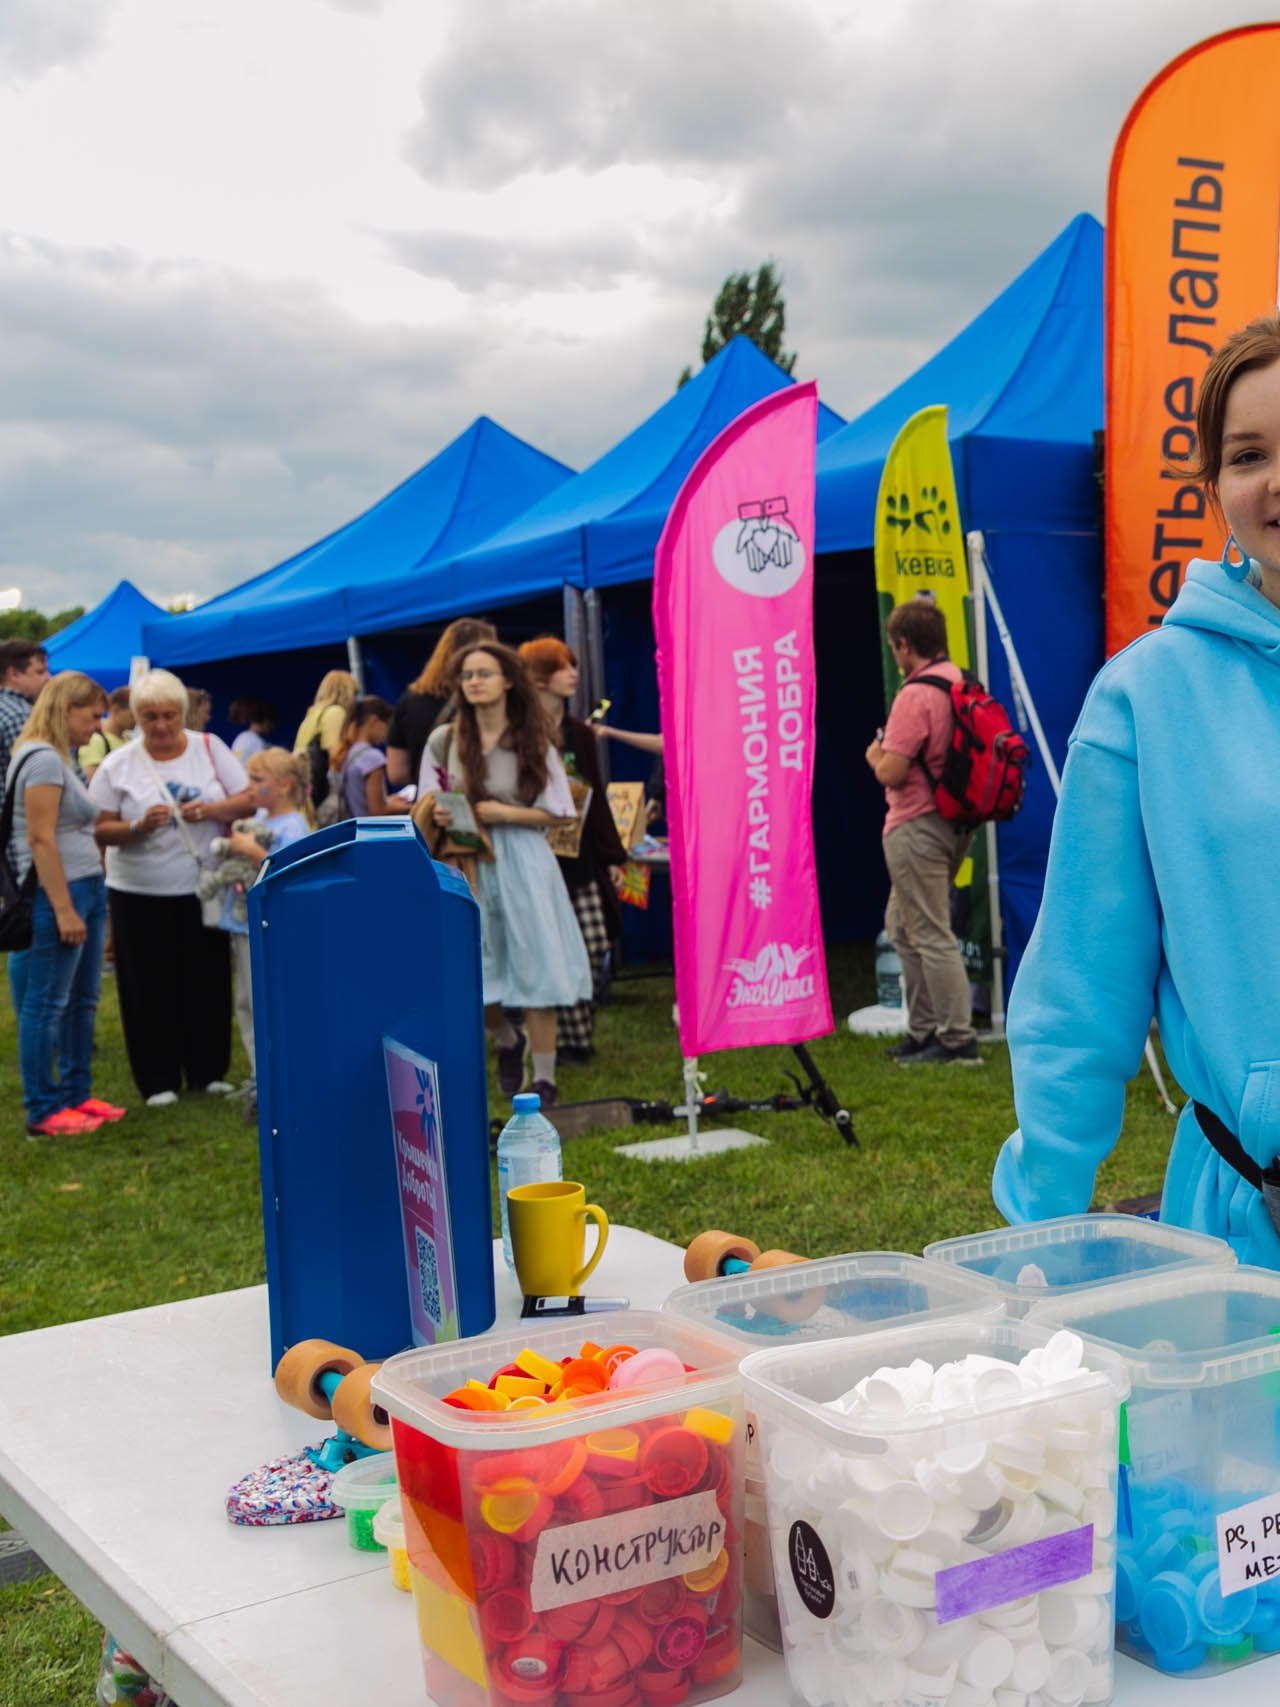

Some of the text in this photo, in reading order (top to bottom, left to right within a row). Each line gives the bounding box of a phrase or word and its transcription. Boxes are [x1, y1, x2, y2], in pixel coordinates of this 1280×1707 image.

[1168, 157, 1224, 357] лапы
[732, 646, 772, 909] #ГАРМОНИЯ
[773, 630, 805, 770] ДОБРА
